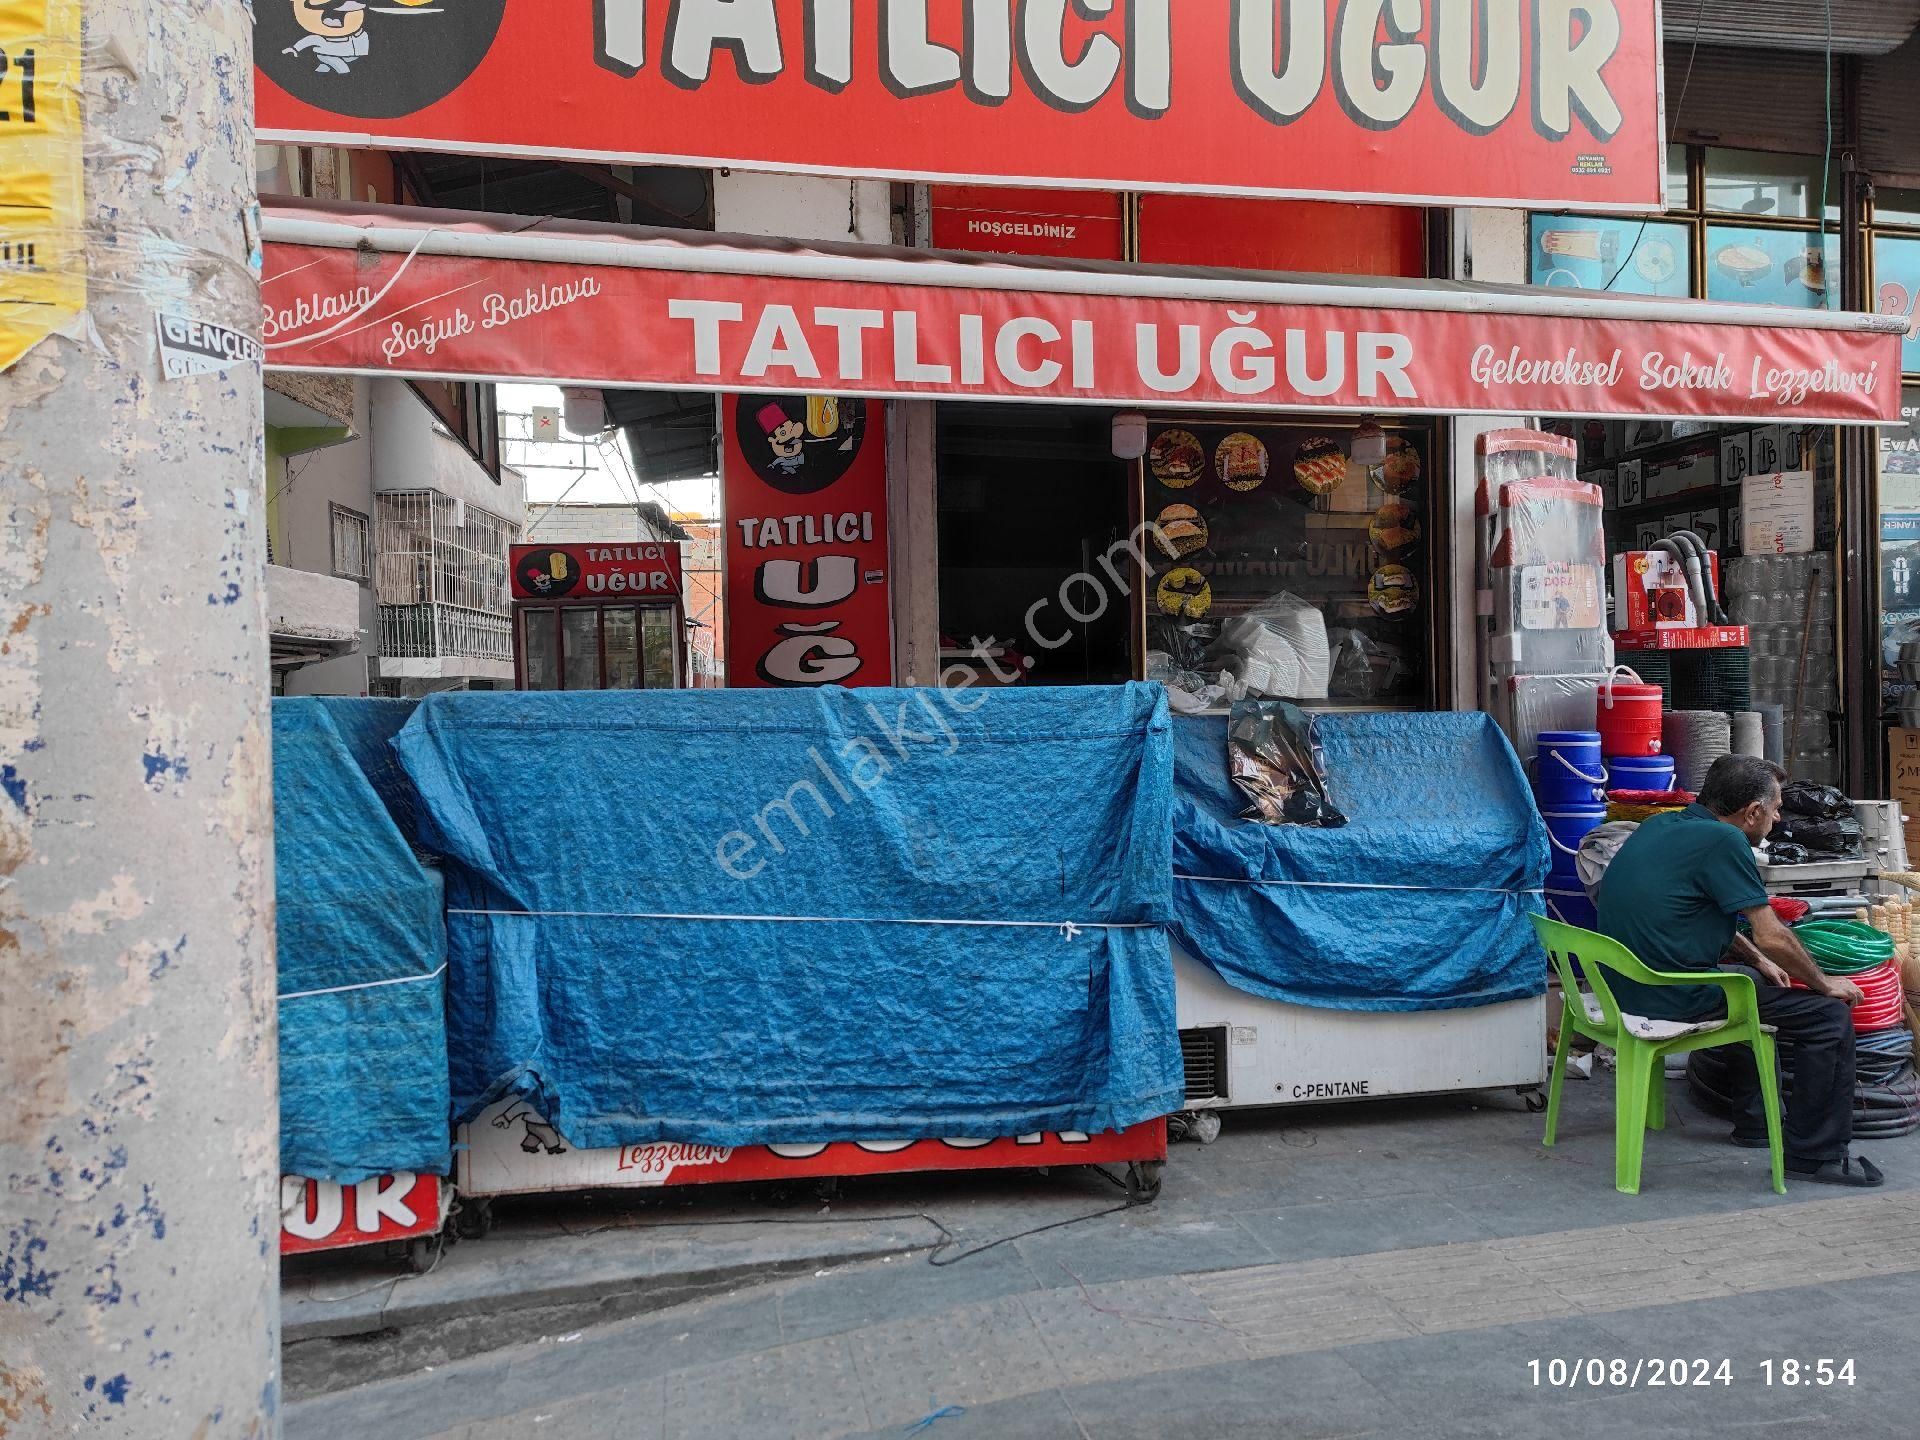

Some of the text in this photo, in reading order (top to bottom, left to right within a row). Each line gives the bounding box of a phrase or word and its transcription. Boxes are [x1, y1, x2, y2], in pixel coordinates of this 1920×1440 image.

[968, 221, 1076, 239] HOŞGELDİNİZ
[382, 273, 601, 364] Soğuk Baklava
[669, 299, 1418, 399] TATLICI UĞUR
[1470, 344, 1879, 405] Geleneksel Sokak Lezzetleri
[738, 511, 873, 548] TATLICI
[586, 546, 666, 563] TATLICI
[586, 567, 669, 593] UĞUR
[1293, 1081, 1369, 1098] C-PENTANE
